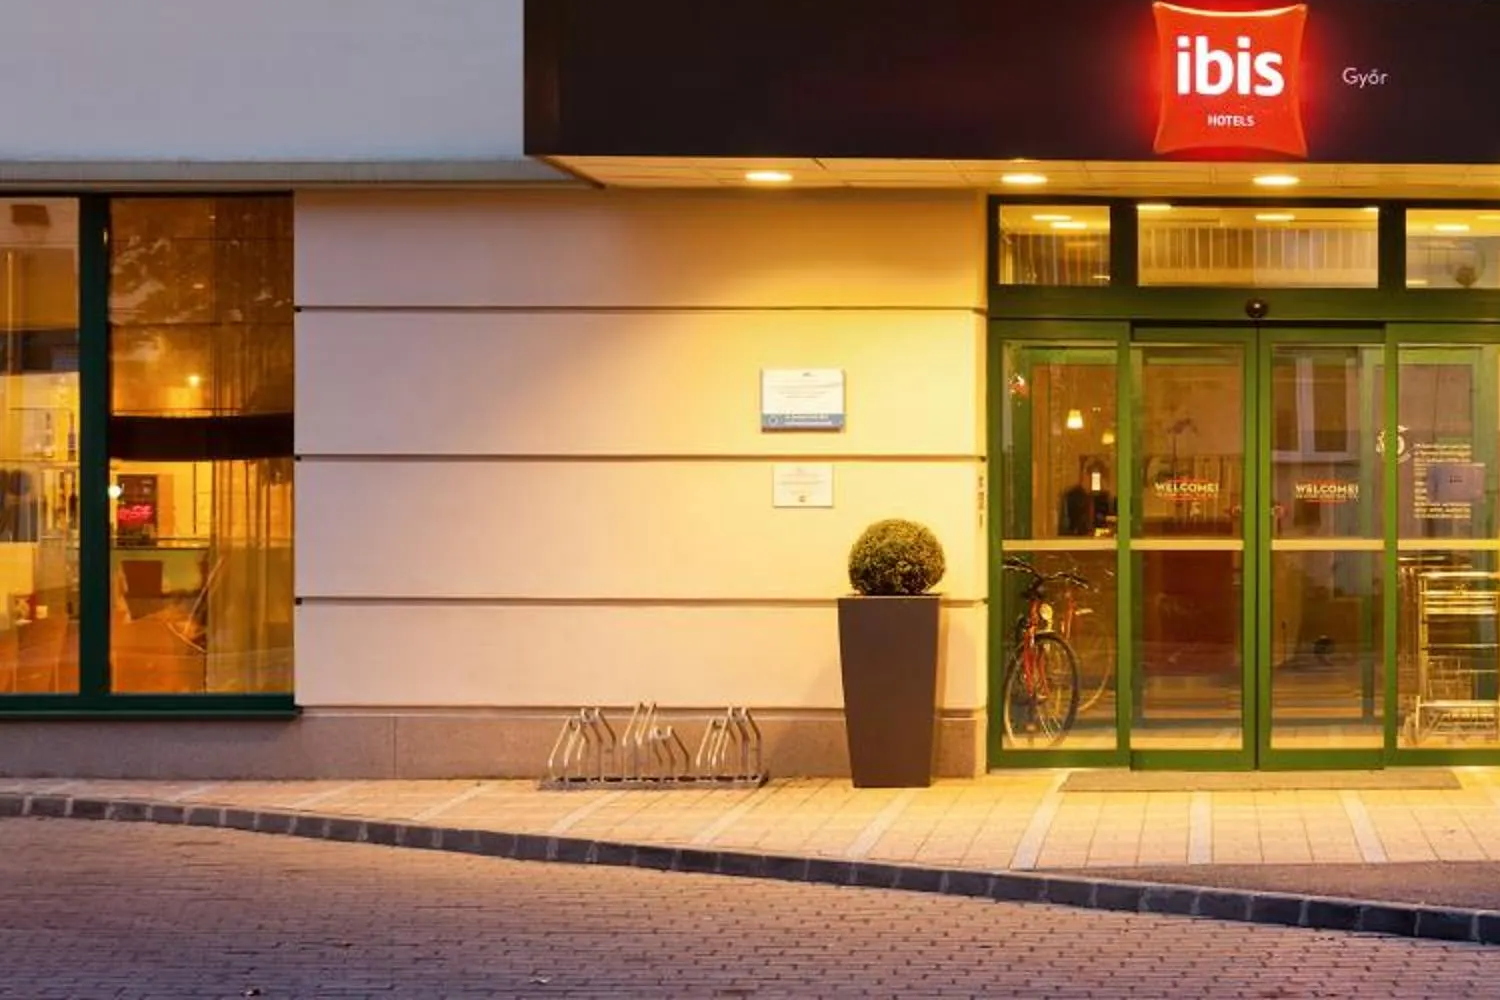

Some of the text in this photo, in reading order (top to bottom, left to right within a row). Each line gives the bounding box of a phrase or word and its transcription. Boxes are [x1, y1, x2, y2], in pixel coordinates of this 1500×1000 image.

[1176, 35, 1285, 97] ibis
[1342, 66, 1389, 89] Győr
[1207, 115, 1255, 127] HOTELS
